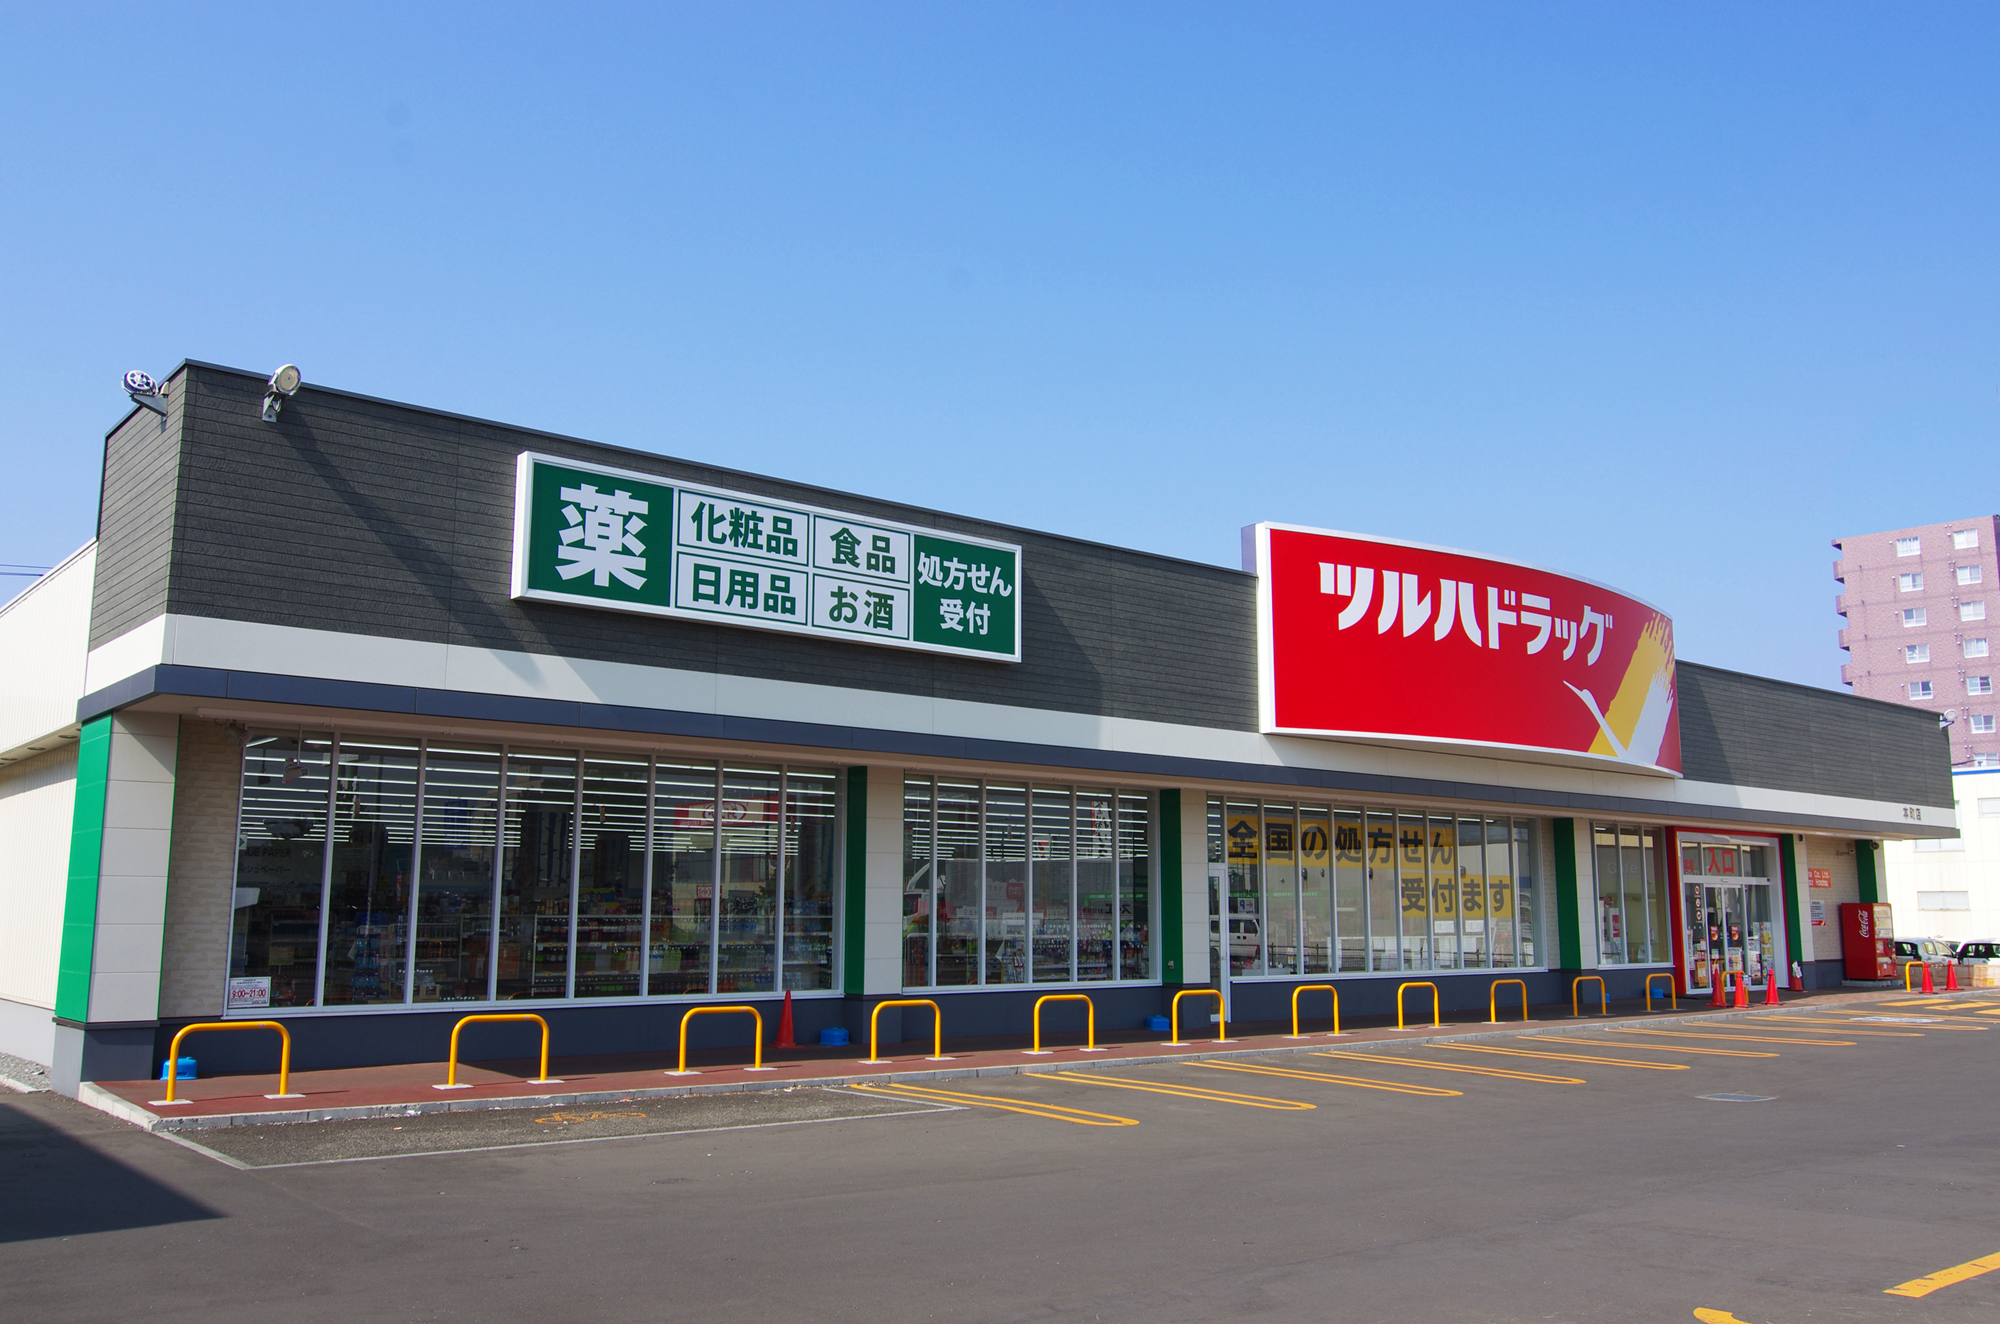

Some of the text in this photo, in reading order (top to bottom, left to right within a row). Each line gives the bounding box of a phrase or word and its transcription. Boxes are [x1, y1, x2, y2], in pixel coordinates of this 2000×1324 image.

[555, 483, 648, 591] 薬
[691, 501, 799, 558] 化粧品
[829, 527, 897, 575] 食品
[691, 562, 797, 616] 日用品
[917, 552, 1013, 598] 処方せん
[828, 585, 895, 631] お酒
[939, 598, 991, 636] 受付
[1318, 561, 1613, 666] ツルハドラッグ
[1902, 805, 1922, 821] 本町店
[262, 848, 291, 858] PAPER
[1227, 820, 1453, 866] 全国の処方せん
[1708, 848, 1735, 874] 入口
[1608, 861, 1638, 874] Cfe
[1401, 877, 1509, 914] 受付ます
